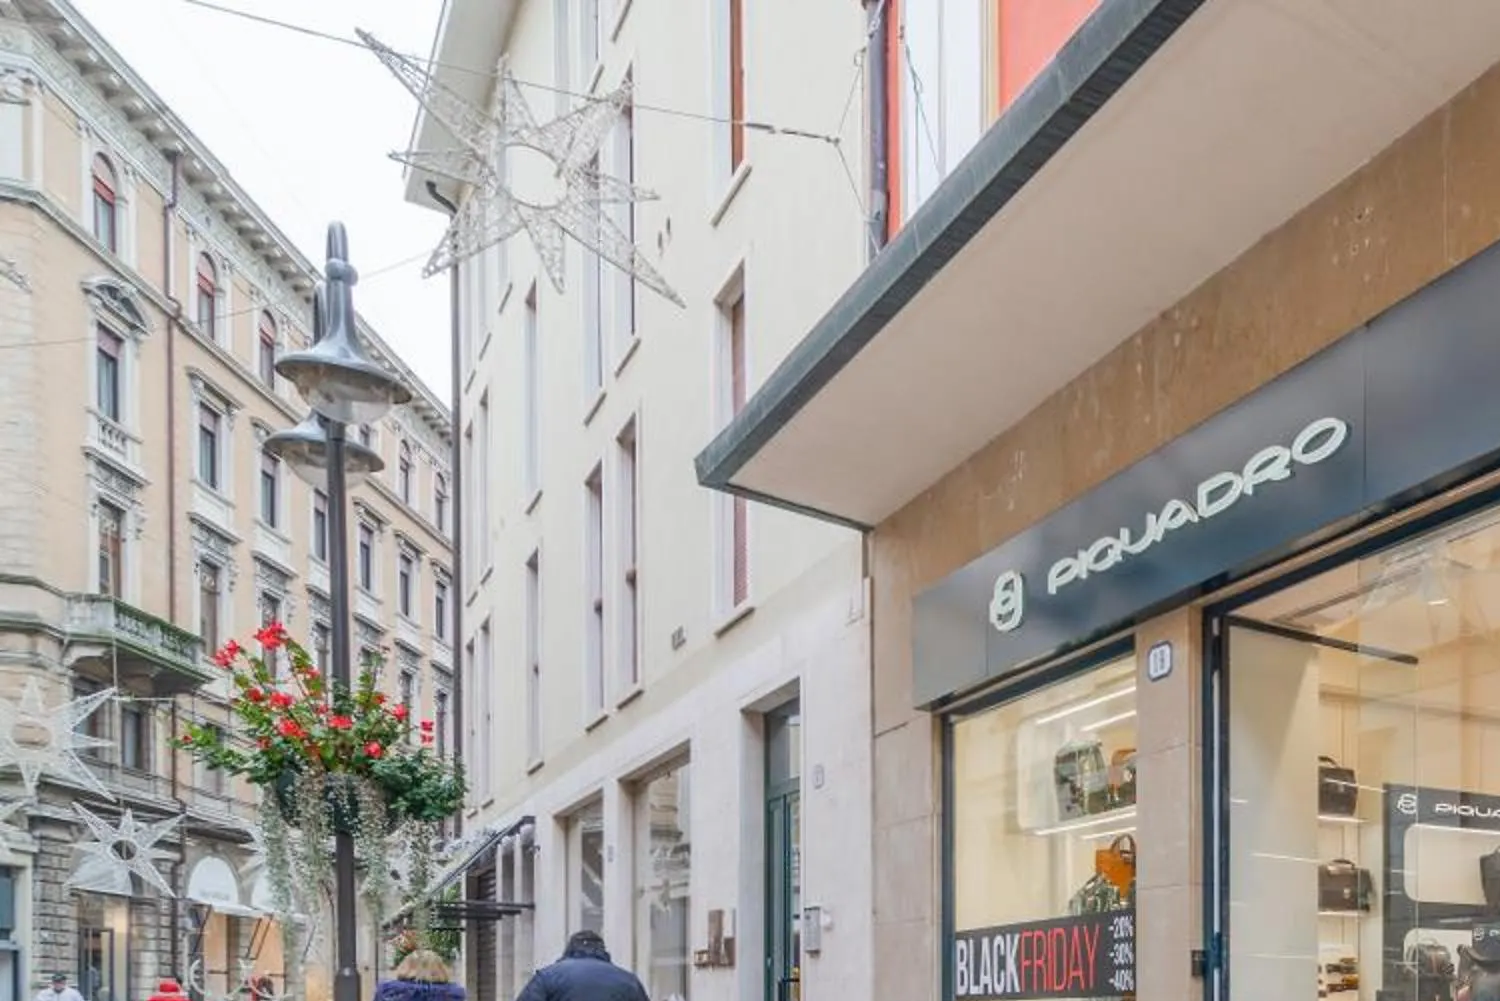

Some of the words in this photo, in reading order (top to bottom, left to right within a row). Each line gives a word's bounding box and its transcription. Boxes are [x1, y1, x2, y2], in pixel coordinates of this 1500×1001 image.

[1047, 417, 1347, 594] PIQUADRO
[956, 933, 1020, 995] BLACK
[1021, 923, 1100, 992] FRIDAY
